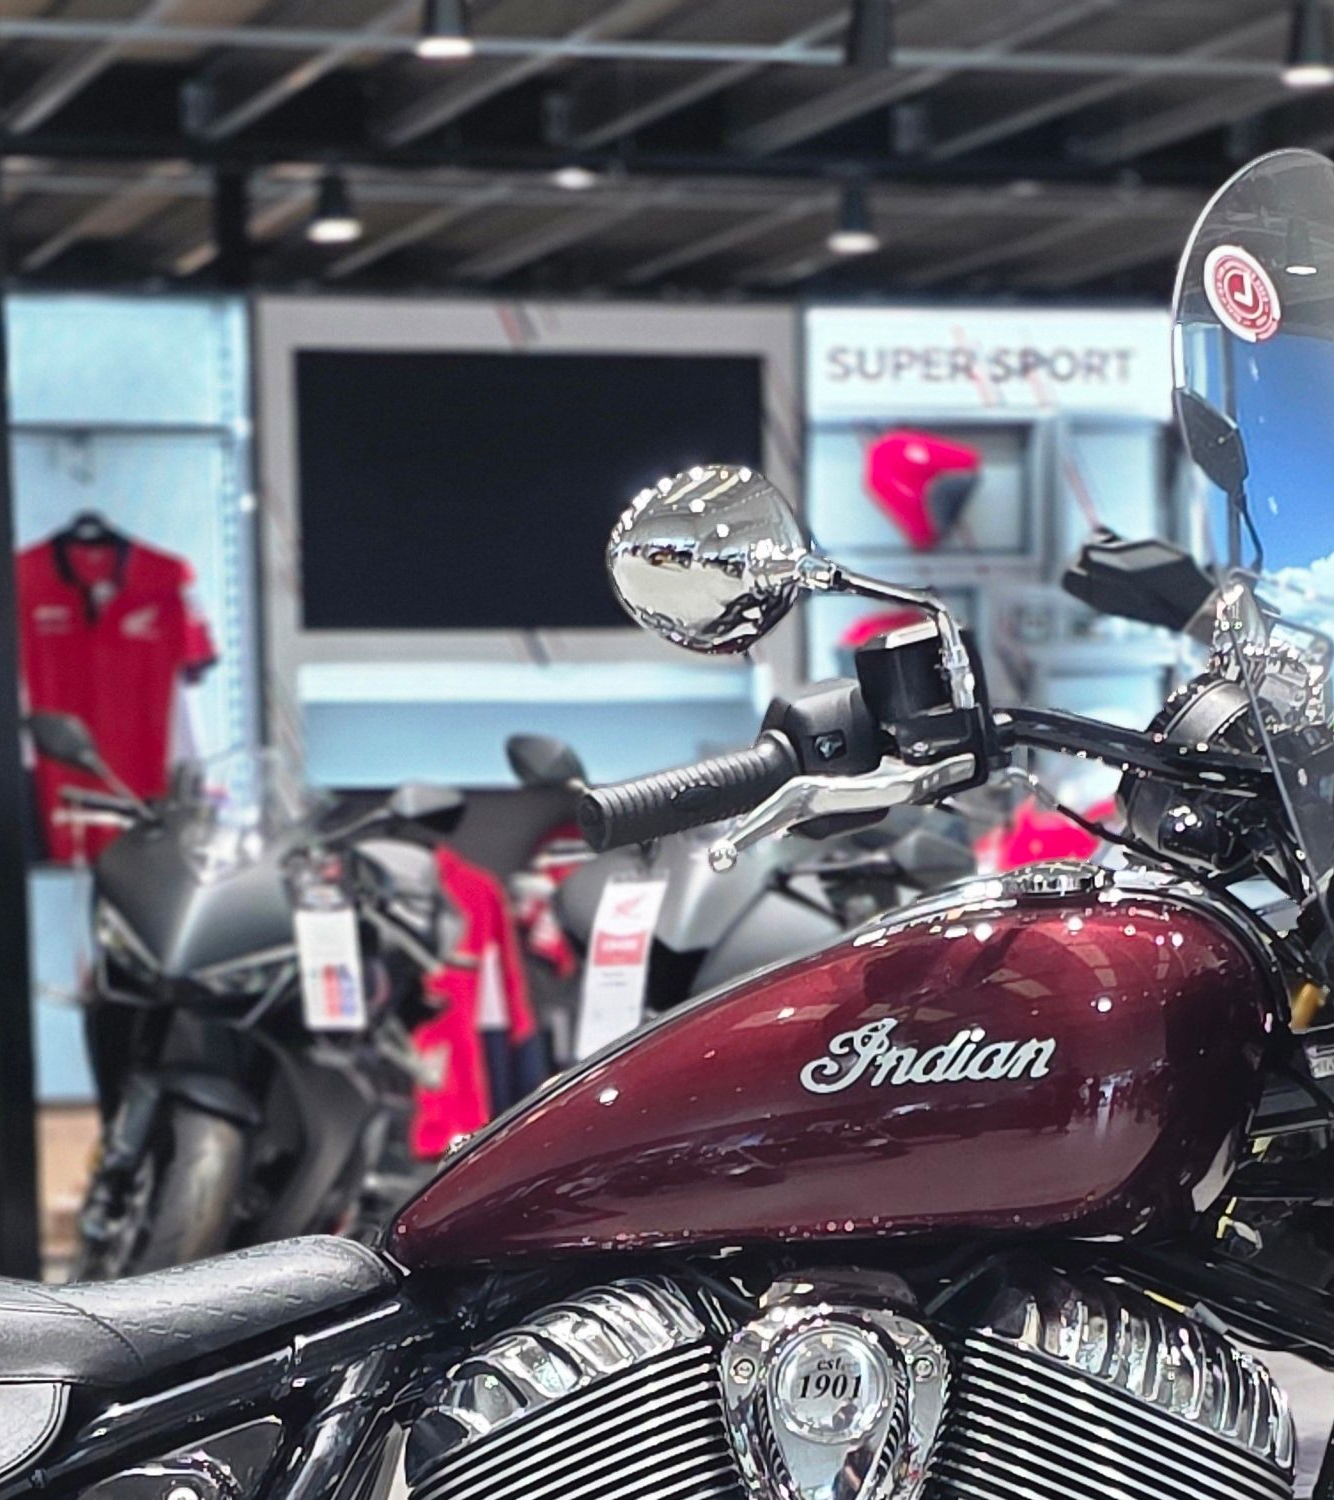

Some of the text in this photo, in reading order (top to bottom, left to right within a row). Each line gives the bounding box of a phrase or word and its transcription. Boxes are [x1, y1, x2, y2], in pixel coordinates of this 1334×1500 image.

[827, 346, 1134, 383] SUPER SPORT
[799, 1017, 1057, 1094] Indian
[800, 1373, 862, 1399] 1901
